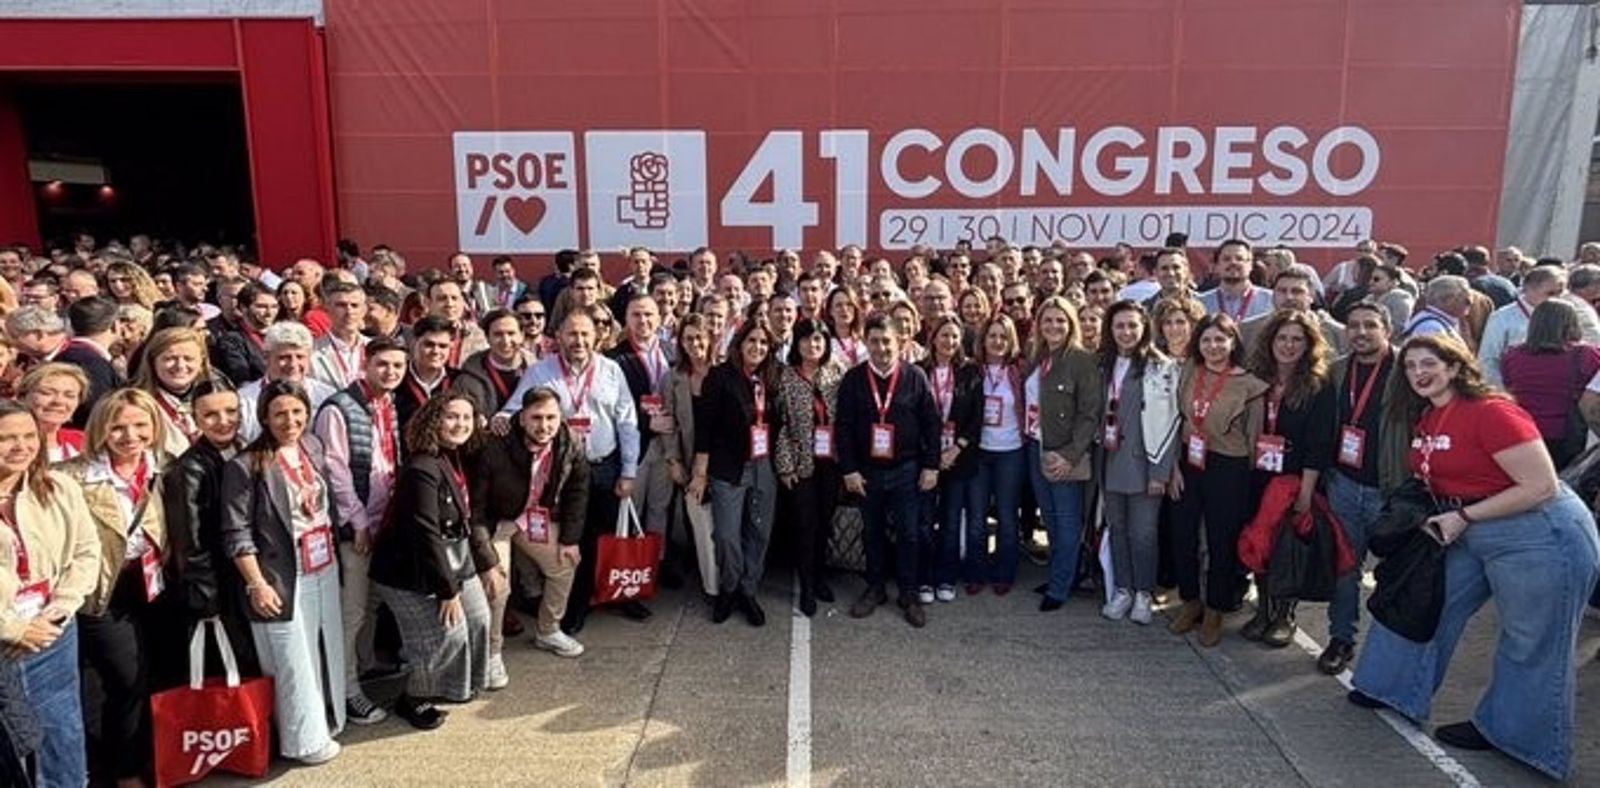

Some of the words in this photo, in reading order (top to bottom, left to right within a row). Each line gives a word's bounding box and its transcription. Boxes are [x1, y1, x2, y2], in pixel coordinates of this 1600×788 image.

[466, 153, 567, 190] PSOE
[721, 129, 869, 250] 41
[880, 126, 1380, 198] CONGRESO
[889, 215, 928, 243] 29
[958, 215, 1000, 242] 30
[1032, 213, 1111, 242] NOV
[1139, 212, 1174, 241] 01
[1206, 212, 1268, 241] DIC
[1278, 212, 1362, 241] 2024
[1256, 451, 1284, 473] 41
[609, 567, 652, 586] PSOE
